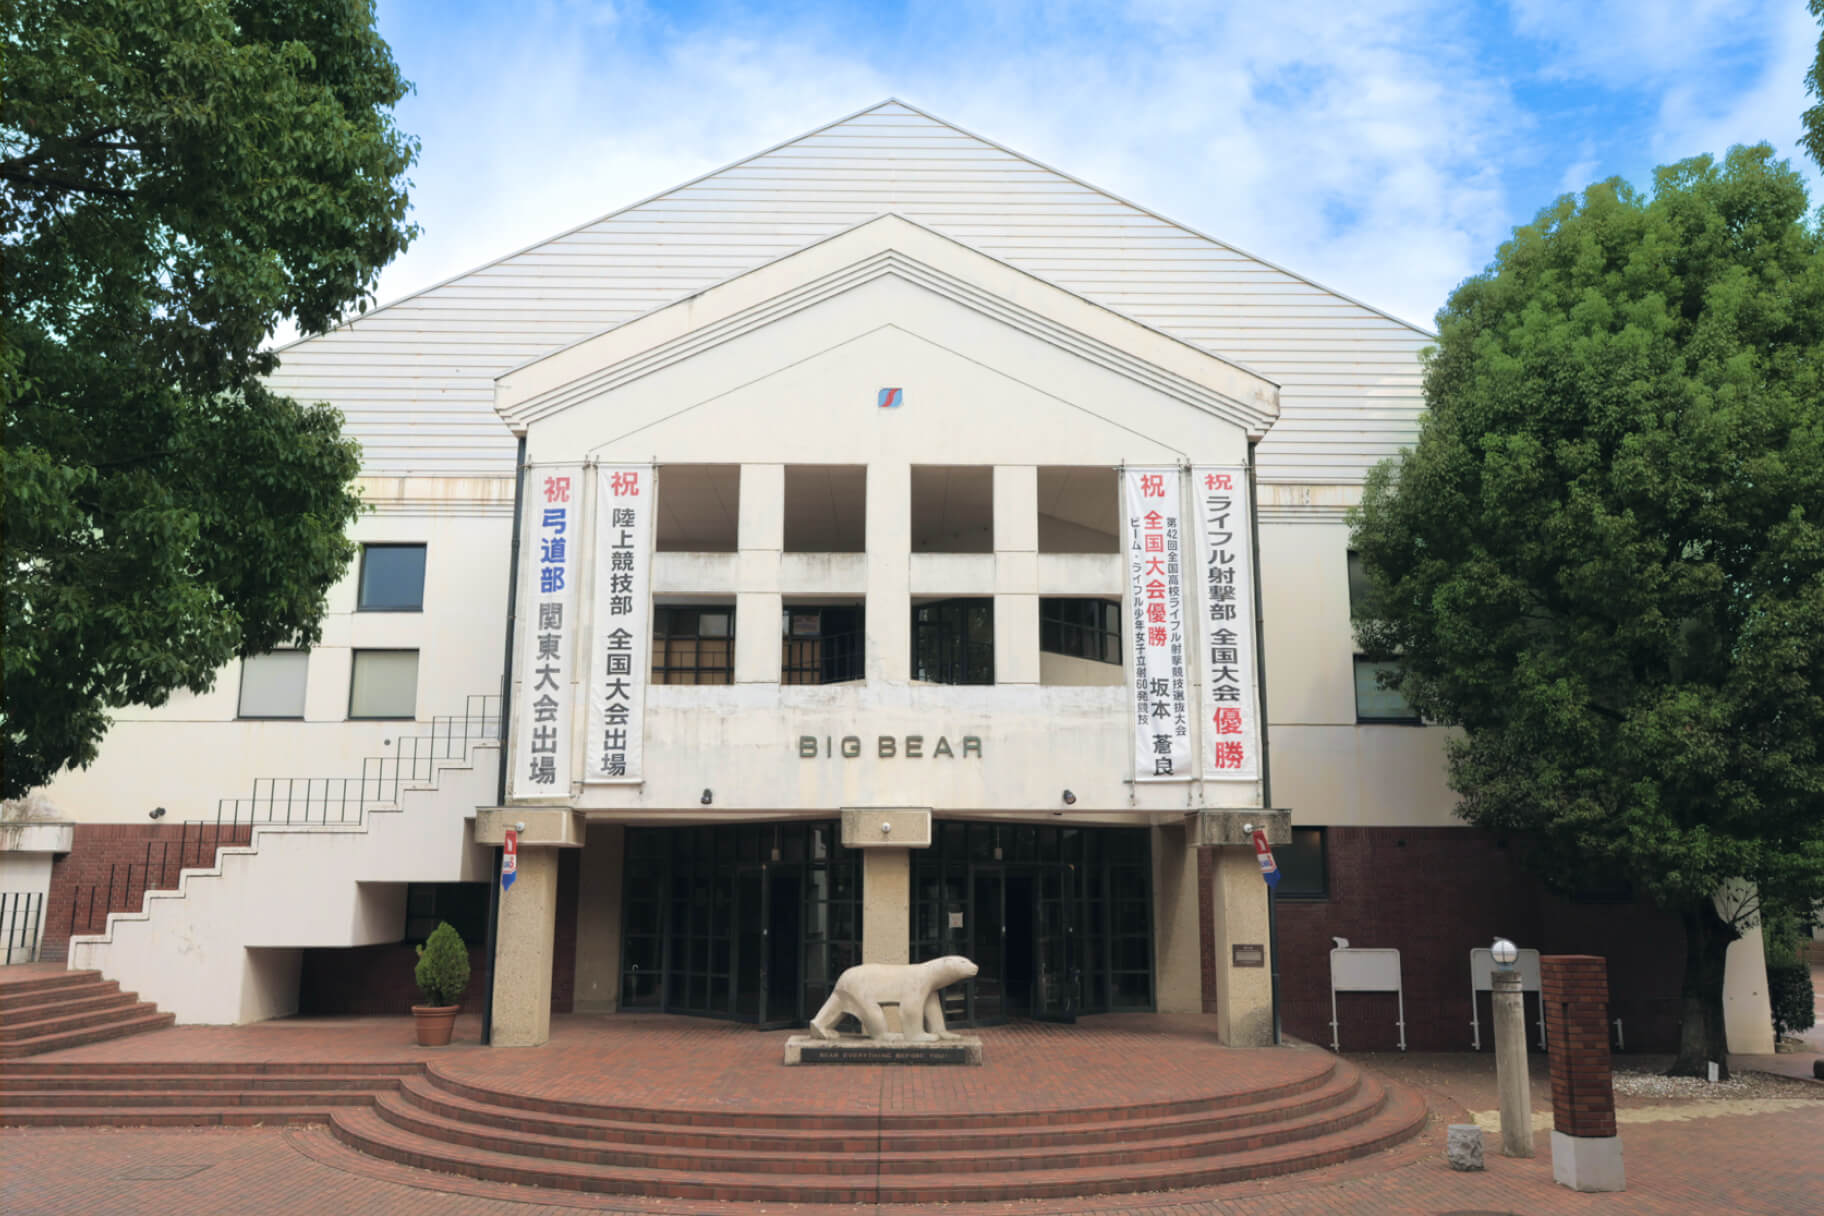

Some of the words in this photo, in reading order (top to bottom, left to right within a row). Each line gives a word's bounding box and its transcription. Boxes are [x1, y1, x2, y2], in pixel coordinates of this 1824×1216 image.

[544, 476, 571, 503] 祝
[610, 471, 640, 497] 祝
[1140, 473, 1165, 498] 祝
[1204, 473, 1233, 491] 祝
[540, 508, 567, 593] 弓道部
[610, 507, 636, 616] 陸上競技部
[1144, 510, 1168, 647] 全国大会優勝
[1206, 495, 1237, 621] ライフル射撃部
[529, 602, 564, 785] 関東大会出場
[600, 627, 633, 777] 全国大会出場
[1150, 677, 1171, 719] 坂本
[799, 736, 861, 758] BIG
[878, 736, 982, 758] BEAR
